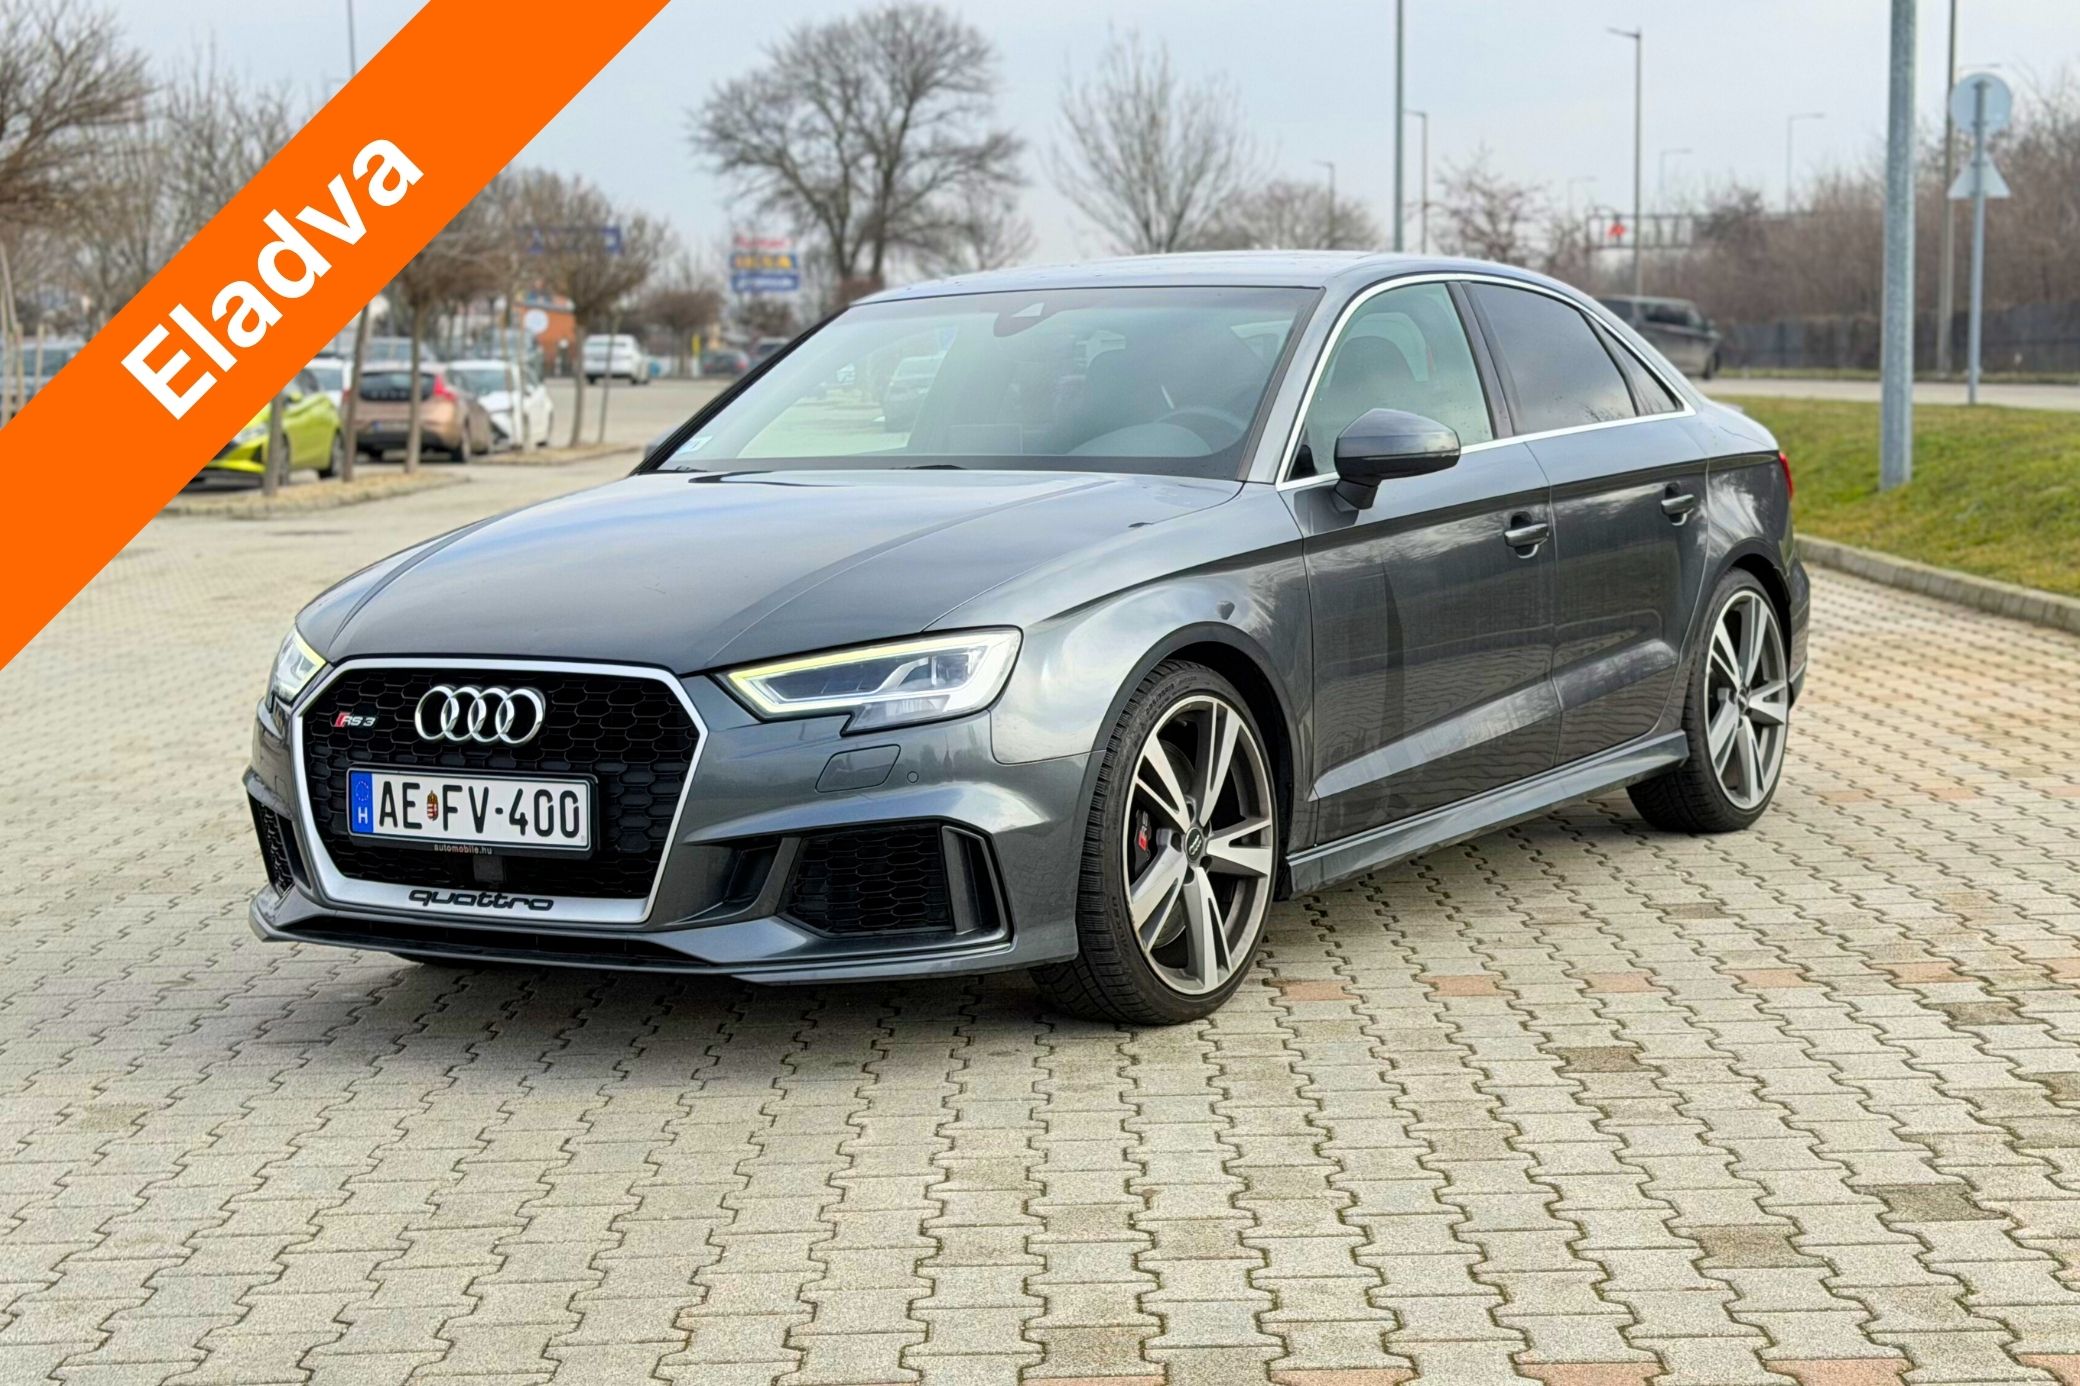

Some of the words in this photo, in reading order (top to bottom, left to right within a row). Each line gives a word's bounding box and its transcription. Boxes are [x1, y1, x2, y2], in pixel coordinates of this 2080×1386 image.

[357, 806, 368, 825] H
[433, 843, 493, 855] automobile.hu
[408, 889, 554, 911] quattro
